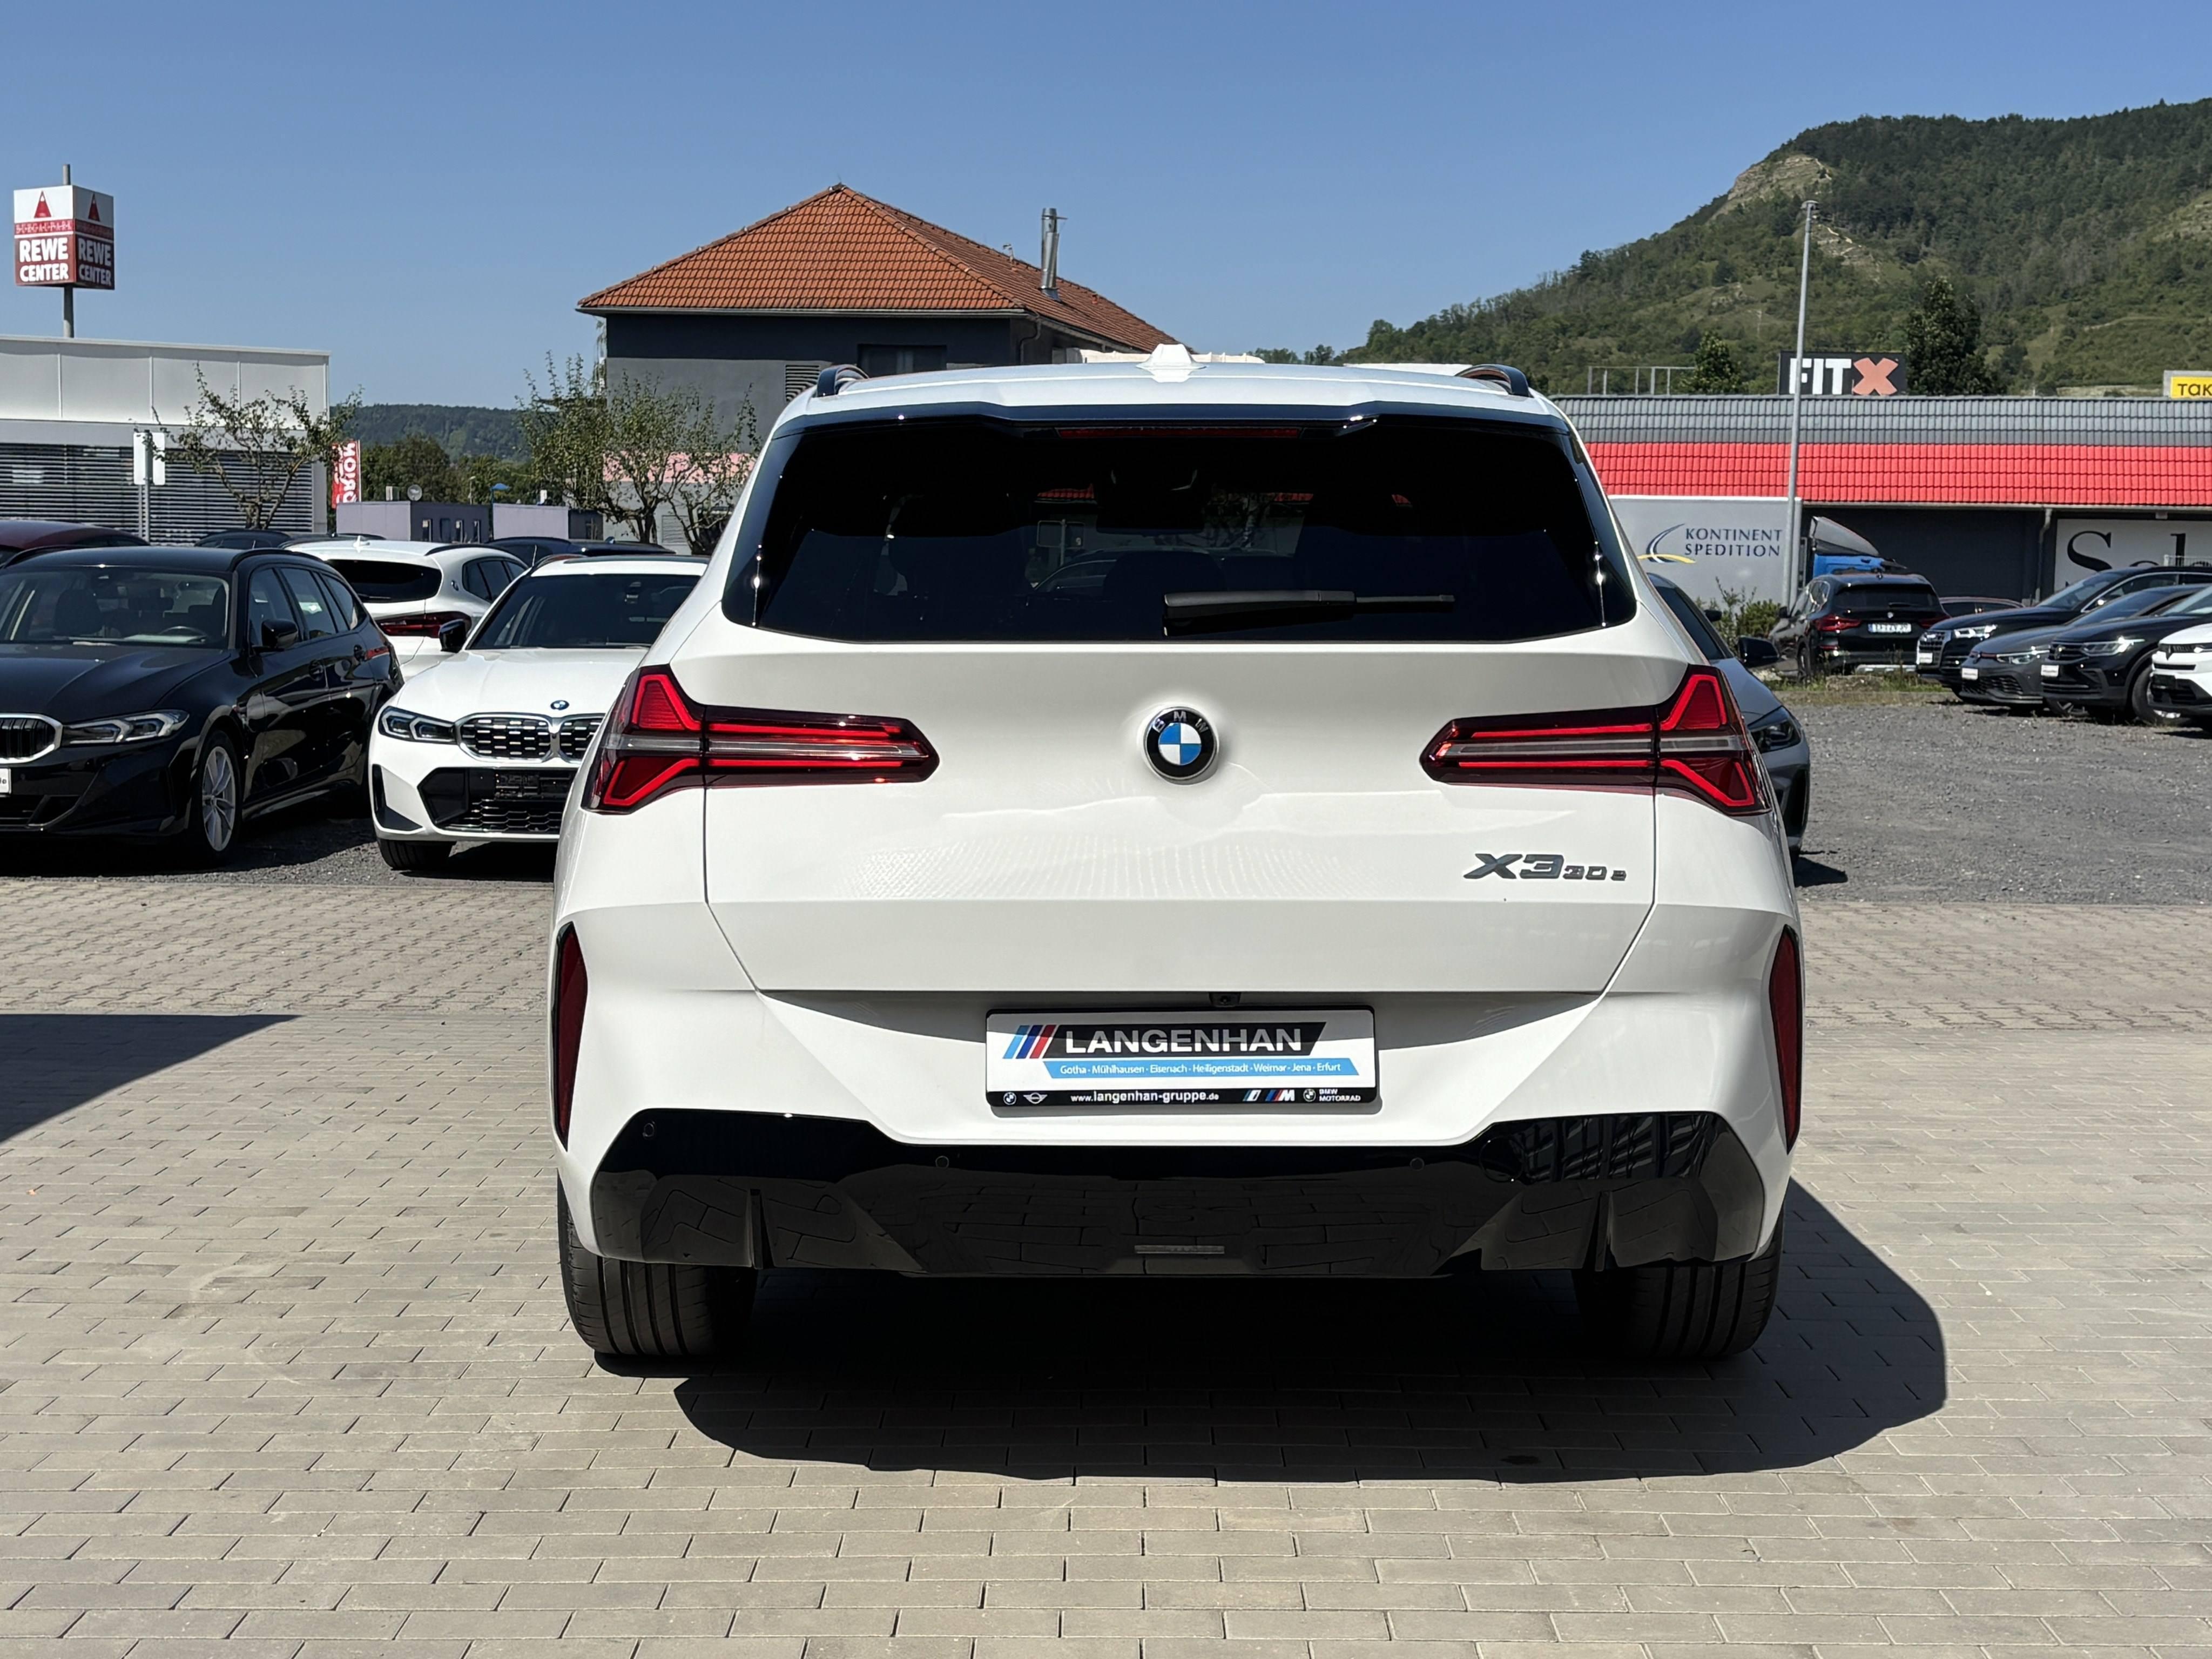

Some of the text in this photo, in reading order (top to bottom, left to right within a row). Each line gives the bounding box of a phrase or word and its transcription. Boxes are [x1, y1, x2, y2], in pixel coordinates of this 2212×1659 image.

[19, 238, 69, 262] REWE
[78, 238, 111, 266] REWE
[20, 263, 69, 282] CENTER
[79, 264, 111, 286] CENTER
[1685, 528, 1782, 541] KONTINENT
[1684, 544, 1779, 557] SPEDITION
[1152, 711, 1209, 733] BMW
[1066, 1029, 1301, 1053] LANGENHAN
[1060, 1062, 1341, 1074] Gotha Mühlhausen Eisenach Heiligenstadt Weimar Jena Erfurt
[1070, 1090, 1219, 1103] www.langenhan-gruppe.de
